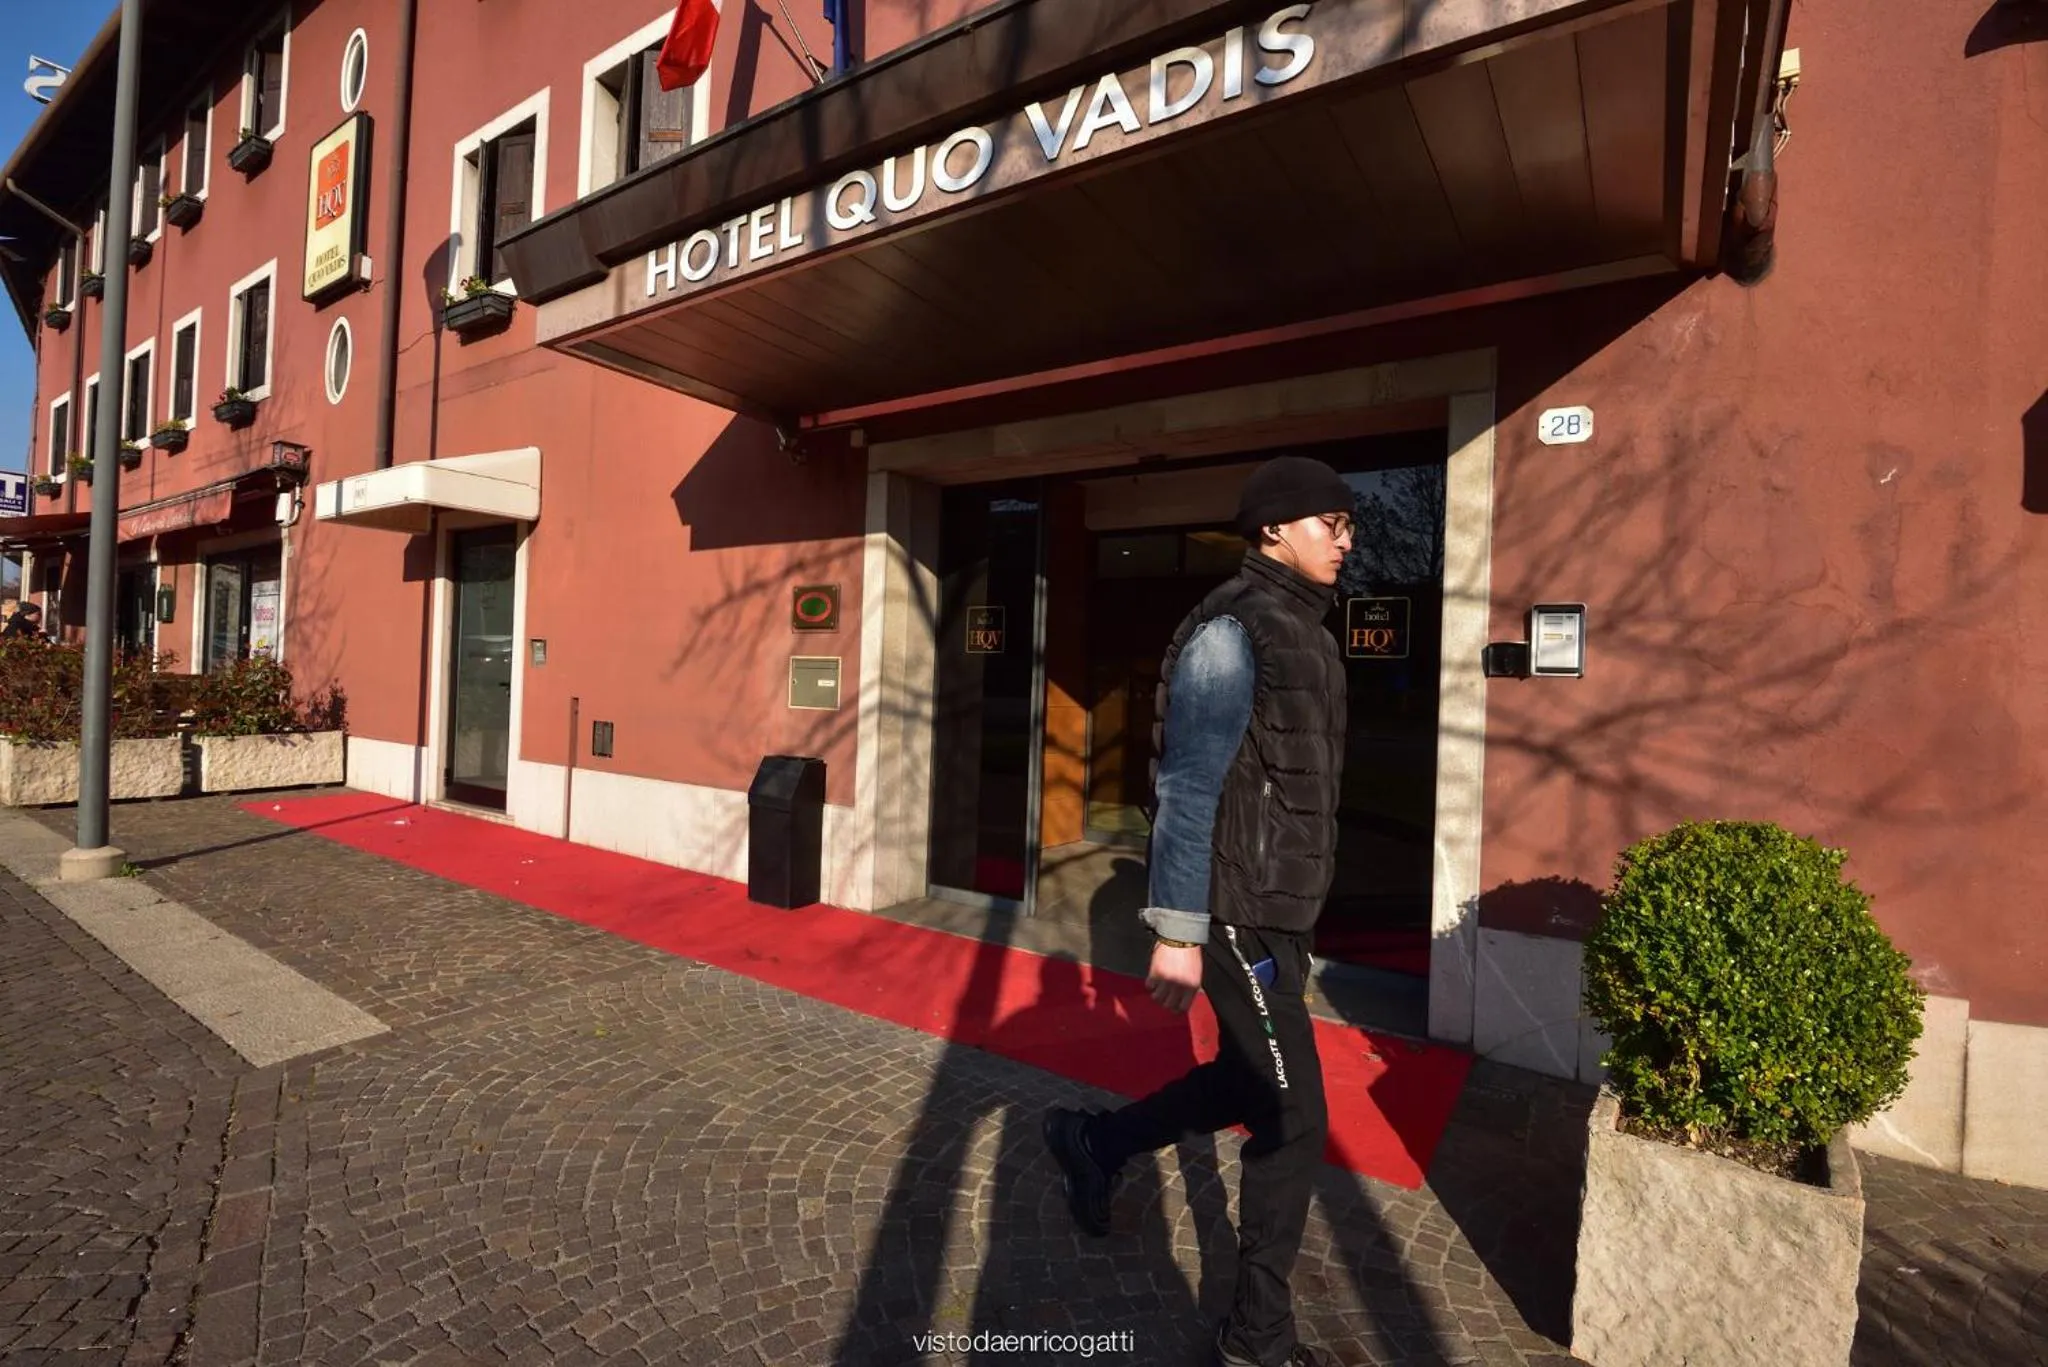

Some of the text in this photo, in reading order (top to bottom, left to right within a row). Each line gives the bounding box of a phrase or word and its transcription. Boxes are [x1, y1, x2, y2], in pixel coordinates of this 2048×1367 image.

[646, 3, 1315, 297] HOTEL QUO VADIS
[315, 244, 341, 268] HOTEL
[1551, 413, 1581, 437] 28
[1268, 1038, 1289, 1089] LACOSTE
